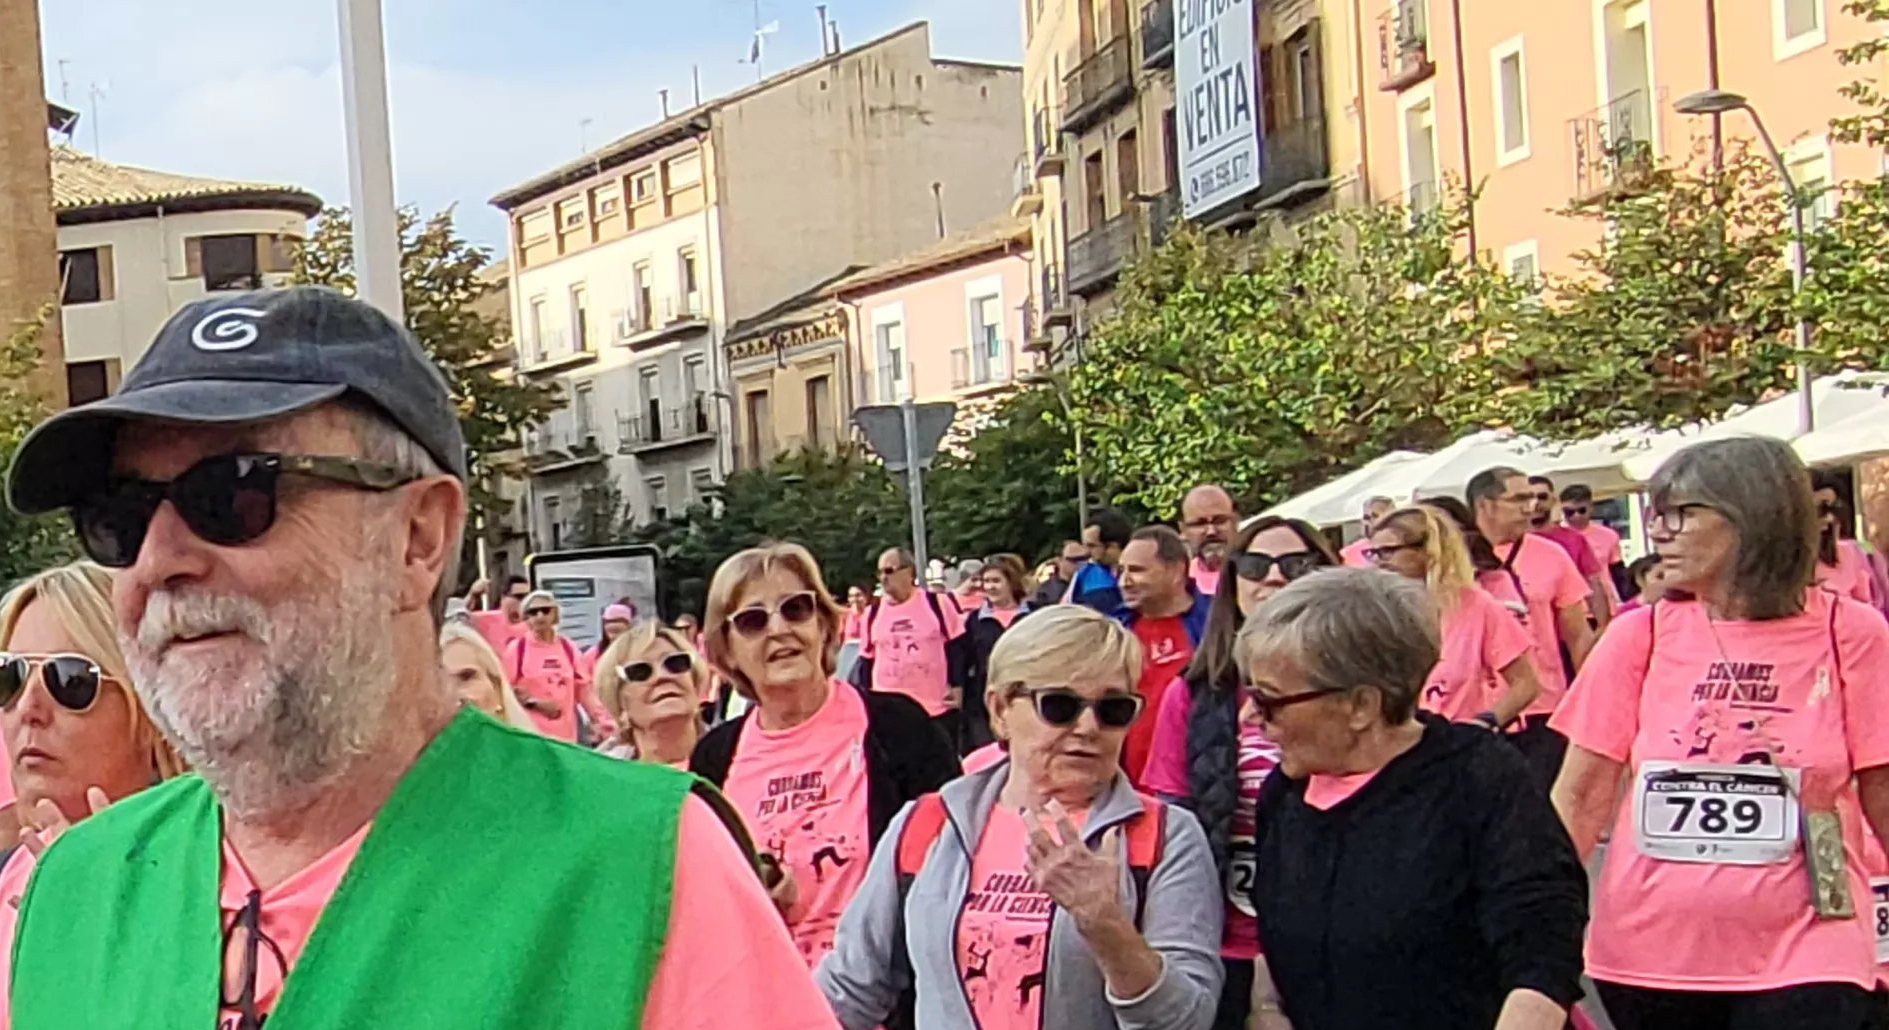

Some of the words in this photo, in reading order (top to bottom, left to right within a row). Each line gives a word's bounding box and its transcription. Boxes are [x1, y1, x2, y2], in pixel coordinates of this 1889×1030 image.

[1179, 0, 1243, 40] EDIF
[1200, 21, 1220, 75] EN
[1184, 61, 1251, 151] VENTA
[1665, 796, 1762, 834] 789
